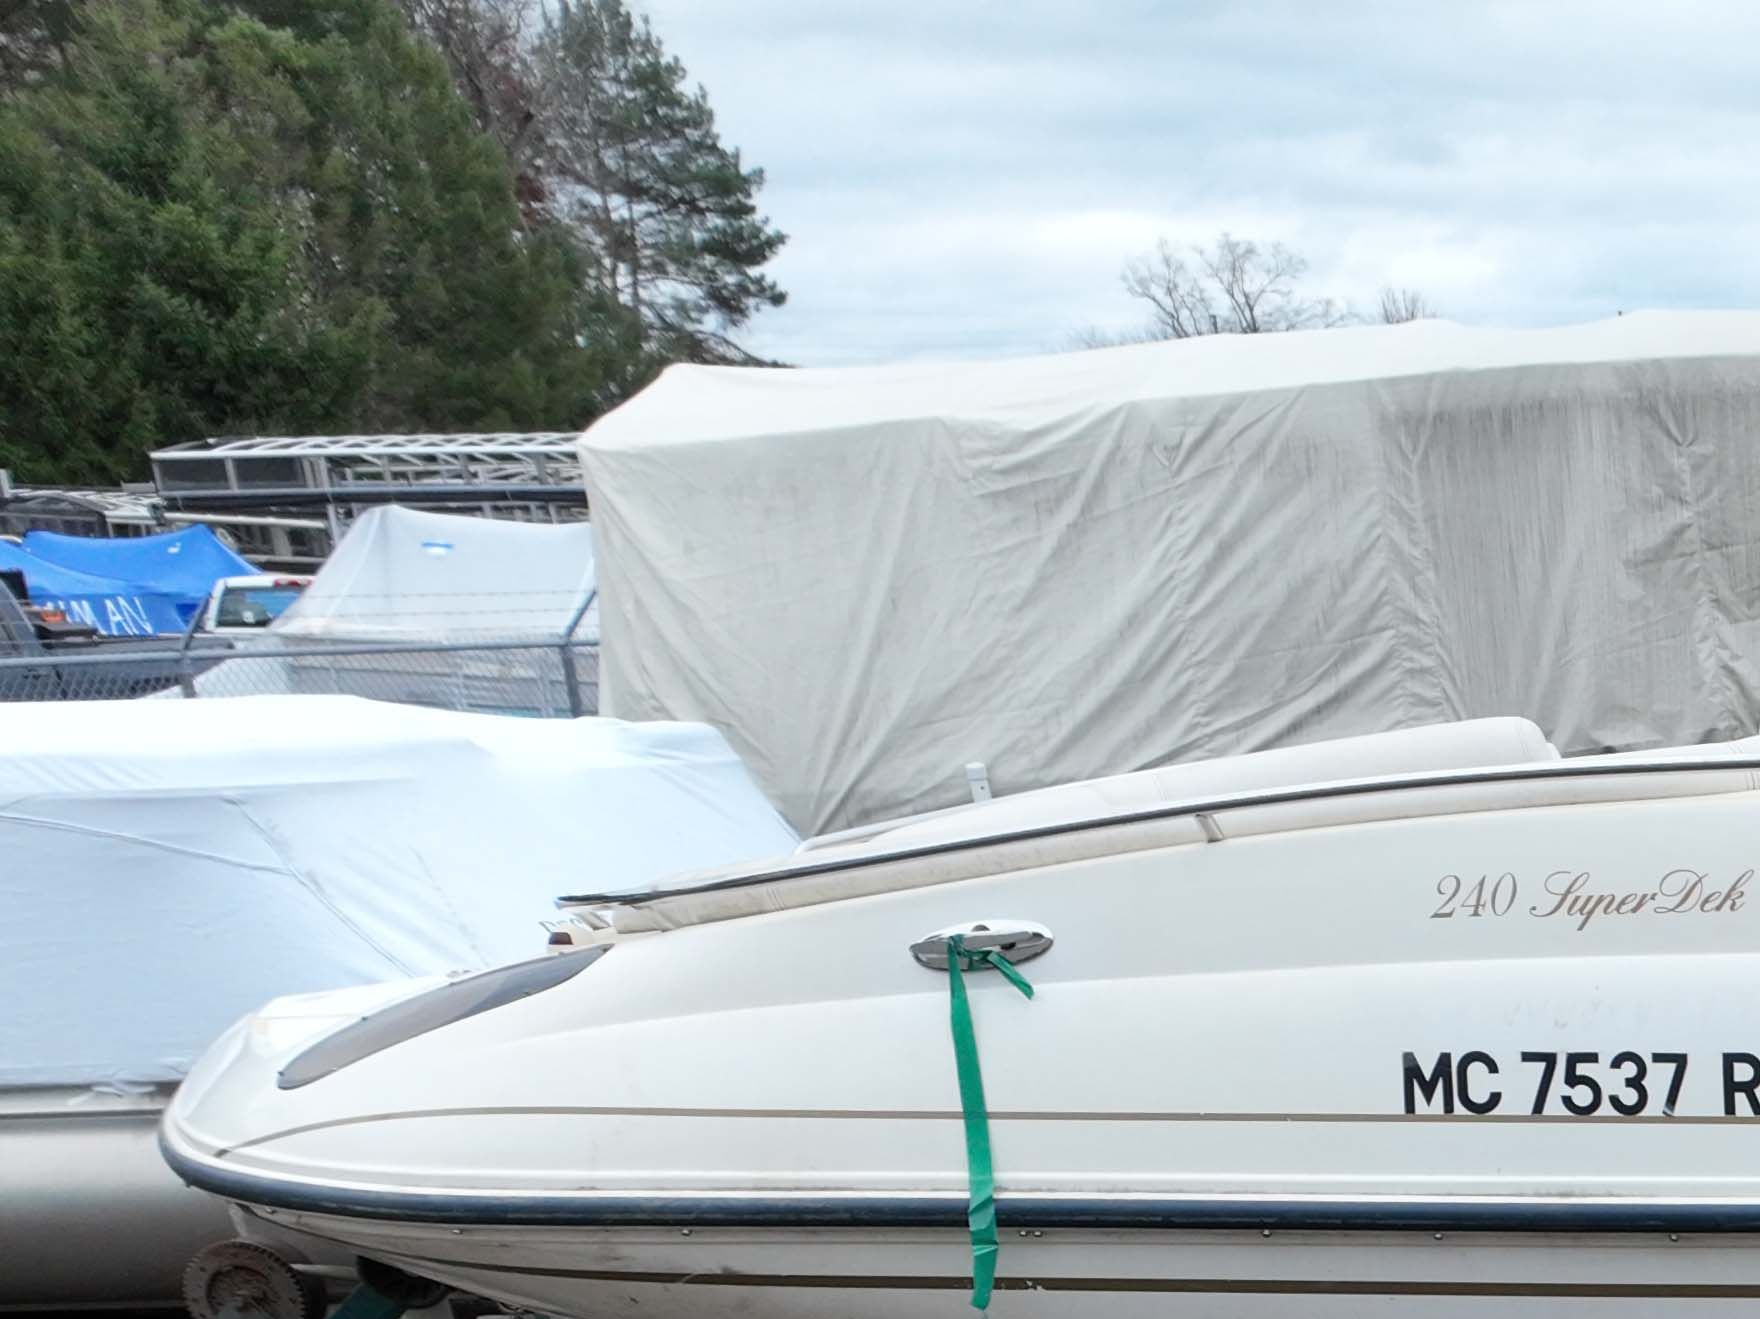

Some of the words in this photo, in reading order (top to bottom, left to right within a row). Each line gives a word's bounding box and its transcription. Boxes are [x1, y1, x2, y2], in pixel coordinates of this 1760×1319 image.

[1430, 872, 1517, 919] 240
[1529, 869, 1754, 931] SuperDek
[1402, 1051, 1502, 1115] MC
[1521, 1051, 1688, 1117] 7537
